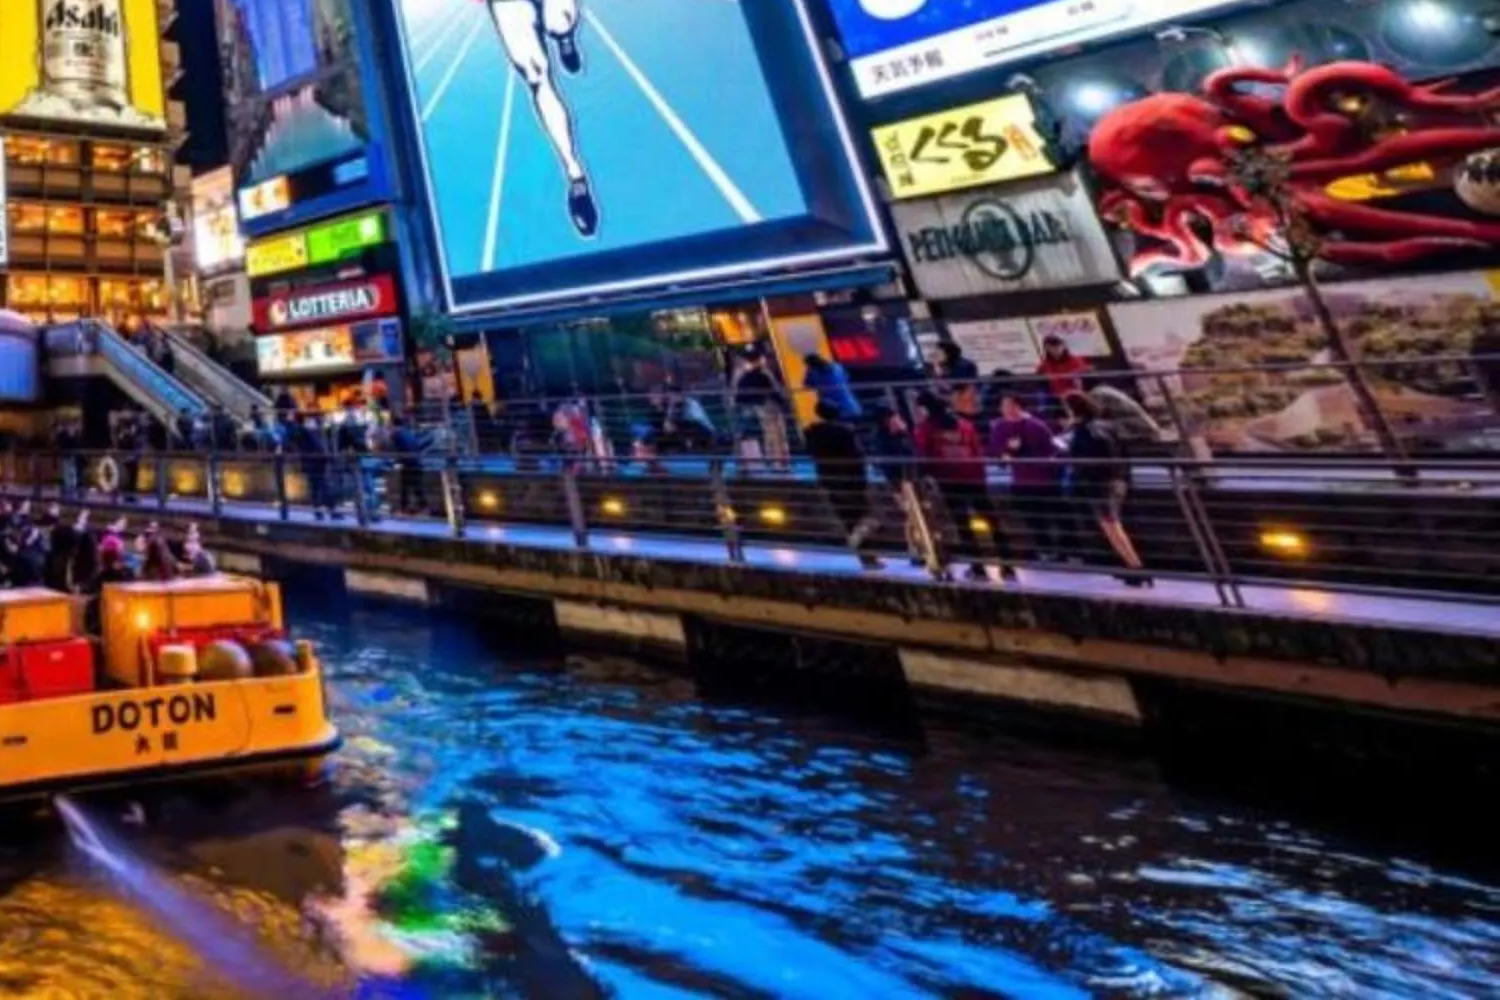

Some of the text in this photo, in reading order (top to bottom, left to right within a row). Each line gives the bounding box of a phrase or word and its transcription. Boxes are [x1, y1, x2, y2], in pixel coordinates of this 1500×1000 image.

[910, 115, 1009, 172] くくる
[288, 286, 370, 319] LOTTERIA
[92, 692, 216, 735] DOTON
